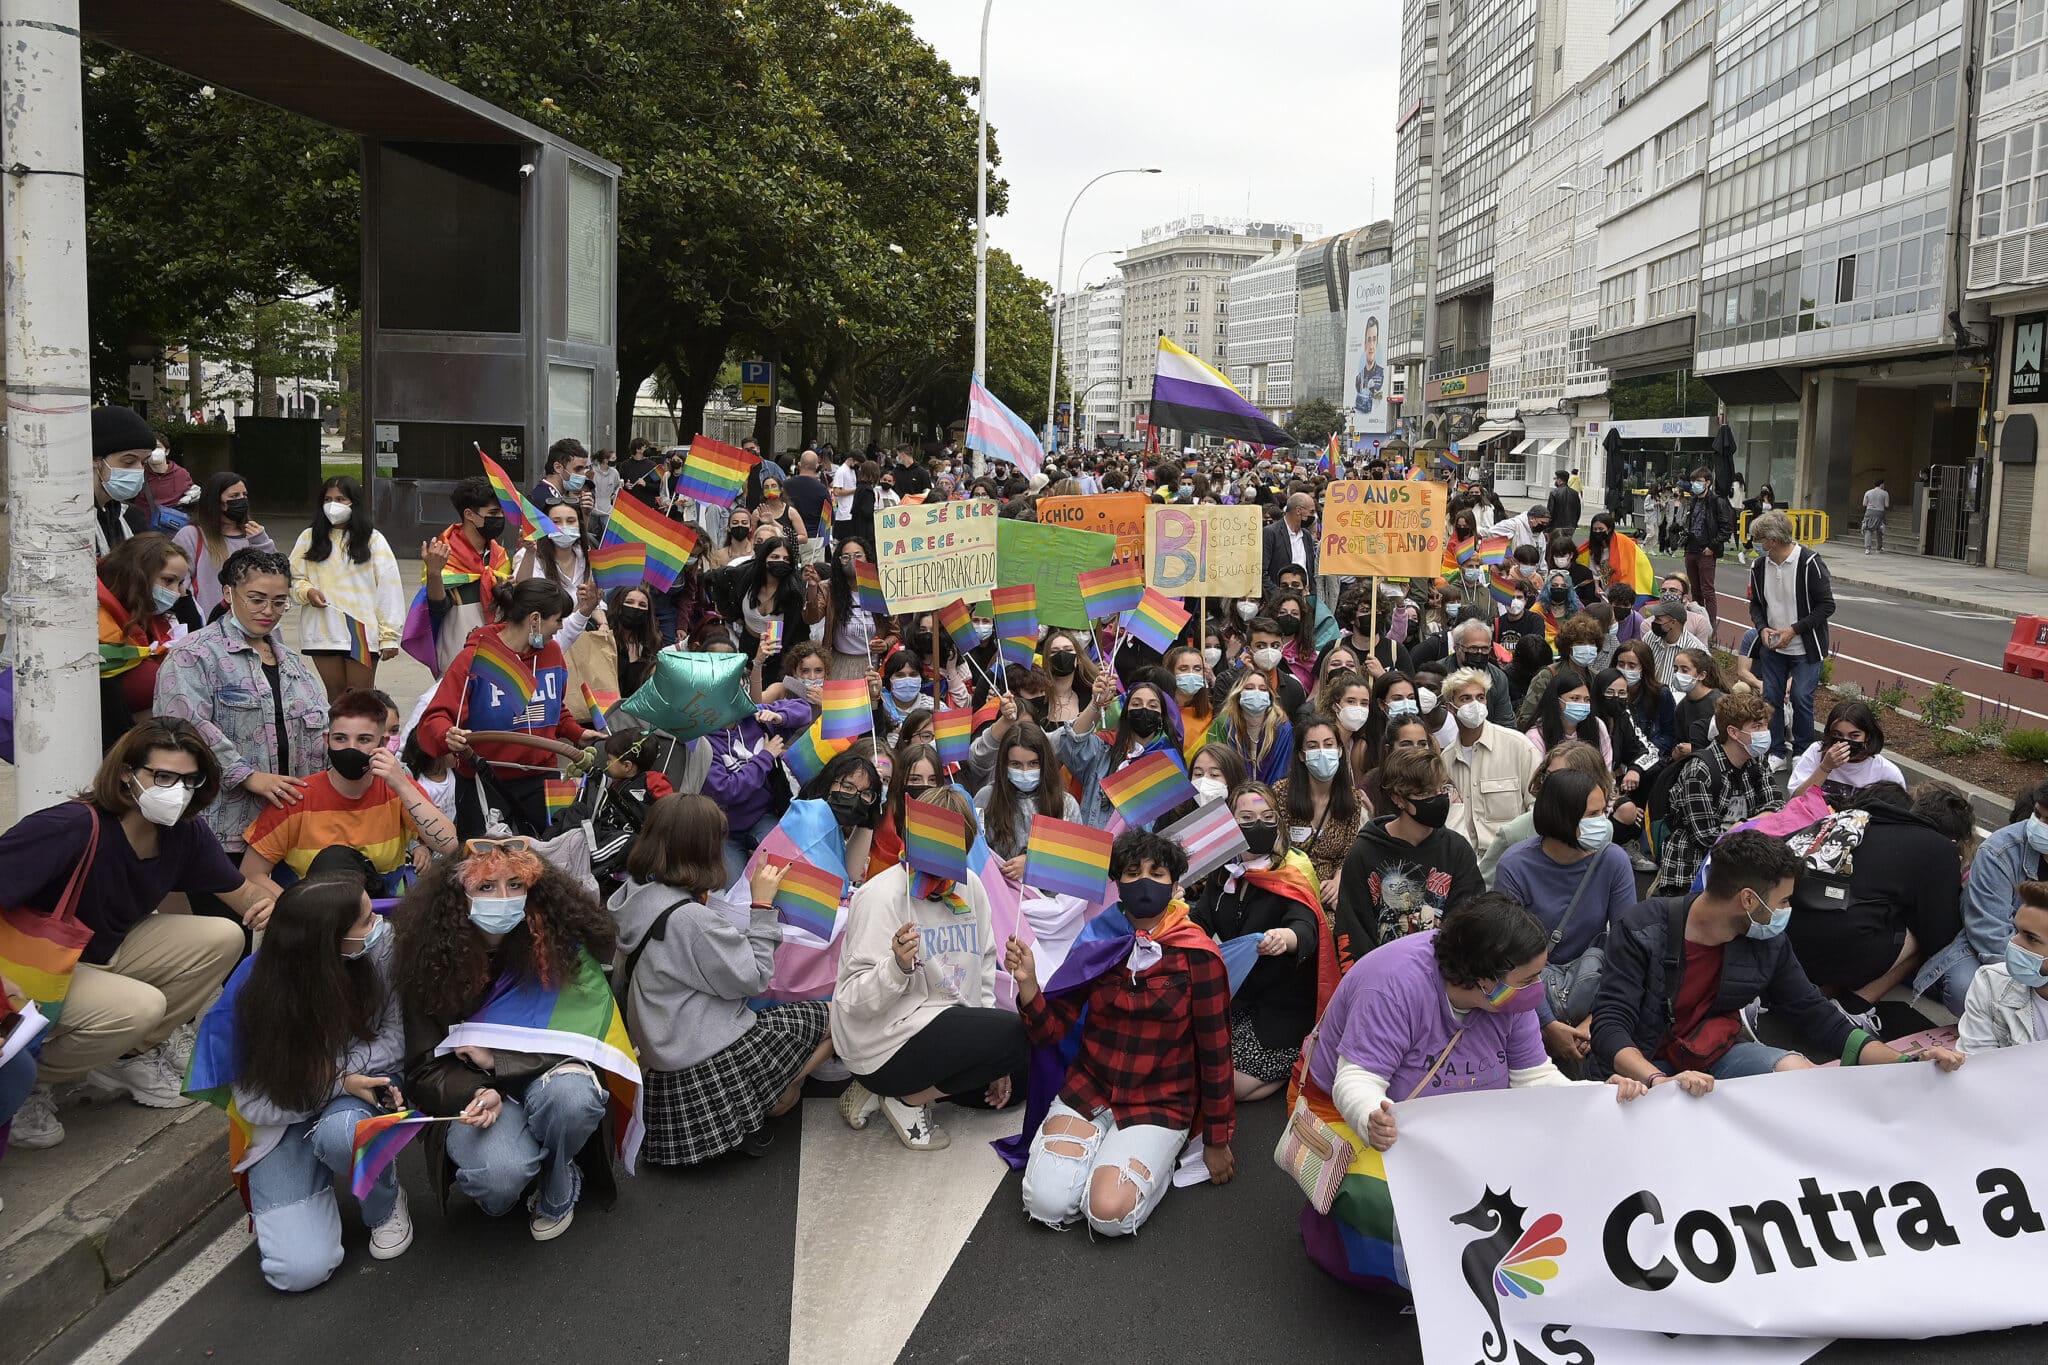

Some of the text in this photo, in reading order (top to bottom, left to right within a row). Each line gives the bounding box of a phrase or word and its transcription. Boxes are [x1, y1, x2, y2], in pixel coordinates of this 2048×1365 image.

[1274, 221, 1323, 234] PASTOR
[750, 364, 763, 381] P
[2013, 373, 2040, 387] VAZVA
[1662, 422, 1683, 434] ABANCA
[1332, 482, 1432, 505] 50 ANOS E
[882, 502, 996, 528] NO SÉ RICK
[1336, 508, 1432, 529] SEGUIMOS
[1152, 508, 1208, 589] BI
[1327, 532, 1439, 556] PROTESTANDO
[1209, 563, 1262, 580] SEXUALES
[1602, 1167, 2046, 1292] Contra a
